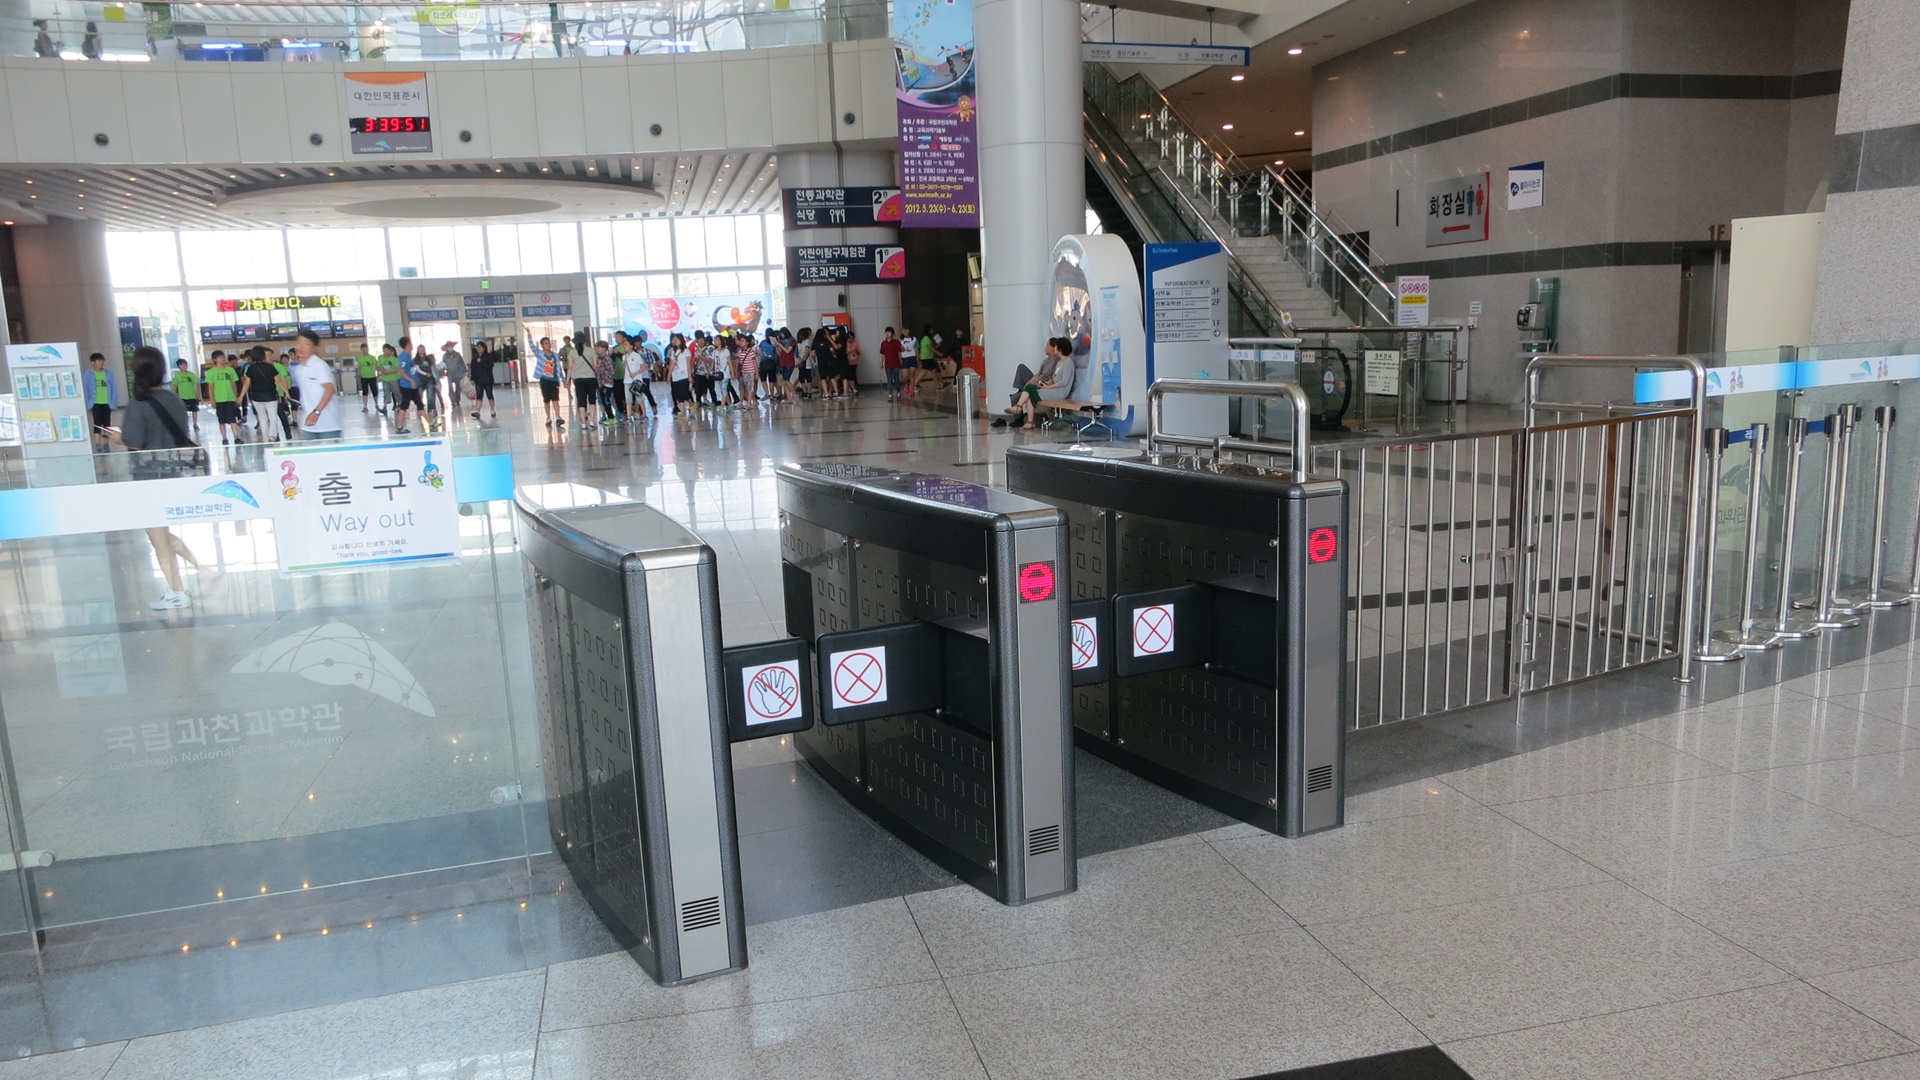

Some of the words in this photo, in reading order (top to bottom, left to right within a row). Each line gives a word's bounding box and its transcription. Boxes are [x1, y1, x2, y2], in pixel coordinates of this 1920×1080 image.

[353, 92, 420, 100] 대한민국표준시
[795, 189, 845, 201] 전통과학관
[873, 191, 882, 204] 2
[905, 204, 921, 213] 2012.
[929, 204, 946, 213] 23(수)
[958, 204, 976, 214] 23(토)
[1429, 190, 1465, 218] 화장실
[796, 209, 816, 221] 식당
[1708, 224, 1726, 241] 1F
[798, 246, 866, 259] 어린이탐구체험관
[876, 249, 883, 263] 1
[799, 266, 848, 278] 기초과학관
[1211, 287, 1221, 295] 3F
[239, 297, 305, 310] 가능합니다.
[527, 306, 557, 315] 들어오는
[317, 472, 353, 506] 출
[372, 469, 407, 502] 구
[165, 502, 233, 516] 국립과천과학관
[319, 513, 369, 533] Way
[378, 509, 415, 529] out
[331, 541, 364, 551] 감사합니다
[366, 540, 386, 549] 안녕히
[387, 538, 410, 547] 가세요.
[371, 548, 405, 557] good-bye.
[104, 701, 343, 755] 국립과천과학관
[108, 753, 178, 772] Gwacheon
[181, 746, 235, 763] National
[239, 739, 288, 755] Science
[289, 734, 343, 750] Museum
